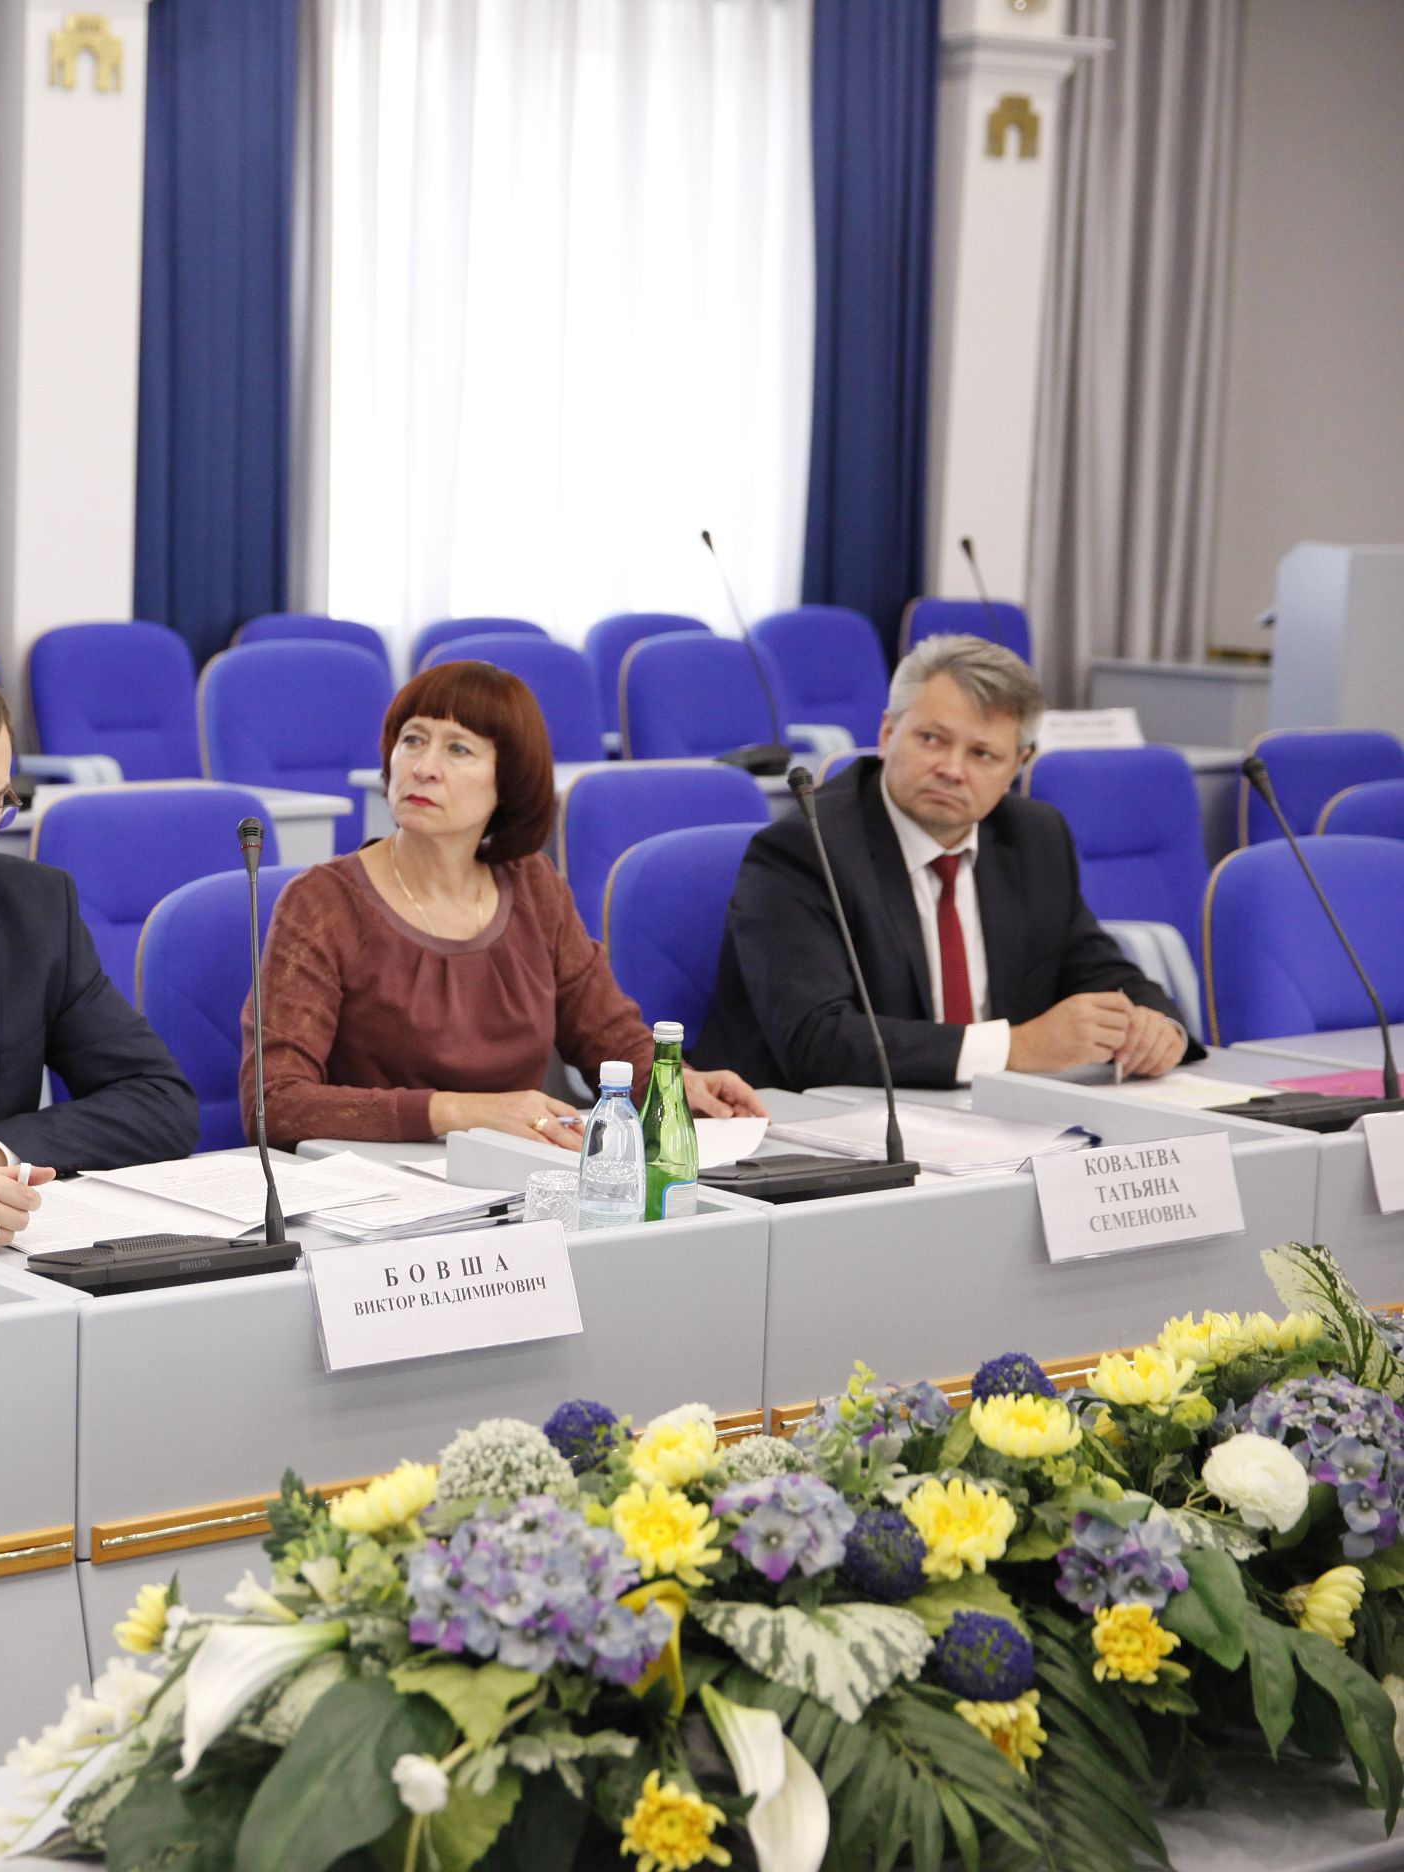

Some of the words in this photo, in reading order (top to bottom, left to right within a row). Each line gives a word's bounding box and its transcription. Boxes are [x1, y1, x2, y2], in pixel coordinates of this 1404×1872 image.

[1084, 1147, 1181, 1176] КОВАЛЕВА
[1095, 1177, 1180, 1204] ТАТЬЯНА
[1089, 1203, 1197, 1233] СЕМЕНОВНА
[179, 1257, 212, 1271] PHILIPS
[353, 1294, 416, 1316] ВИКТОР
[420, 1276, 547, 1307] ВЛАДИМИРОВИЧ
